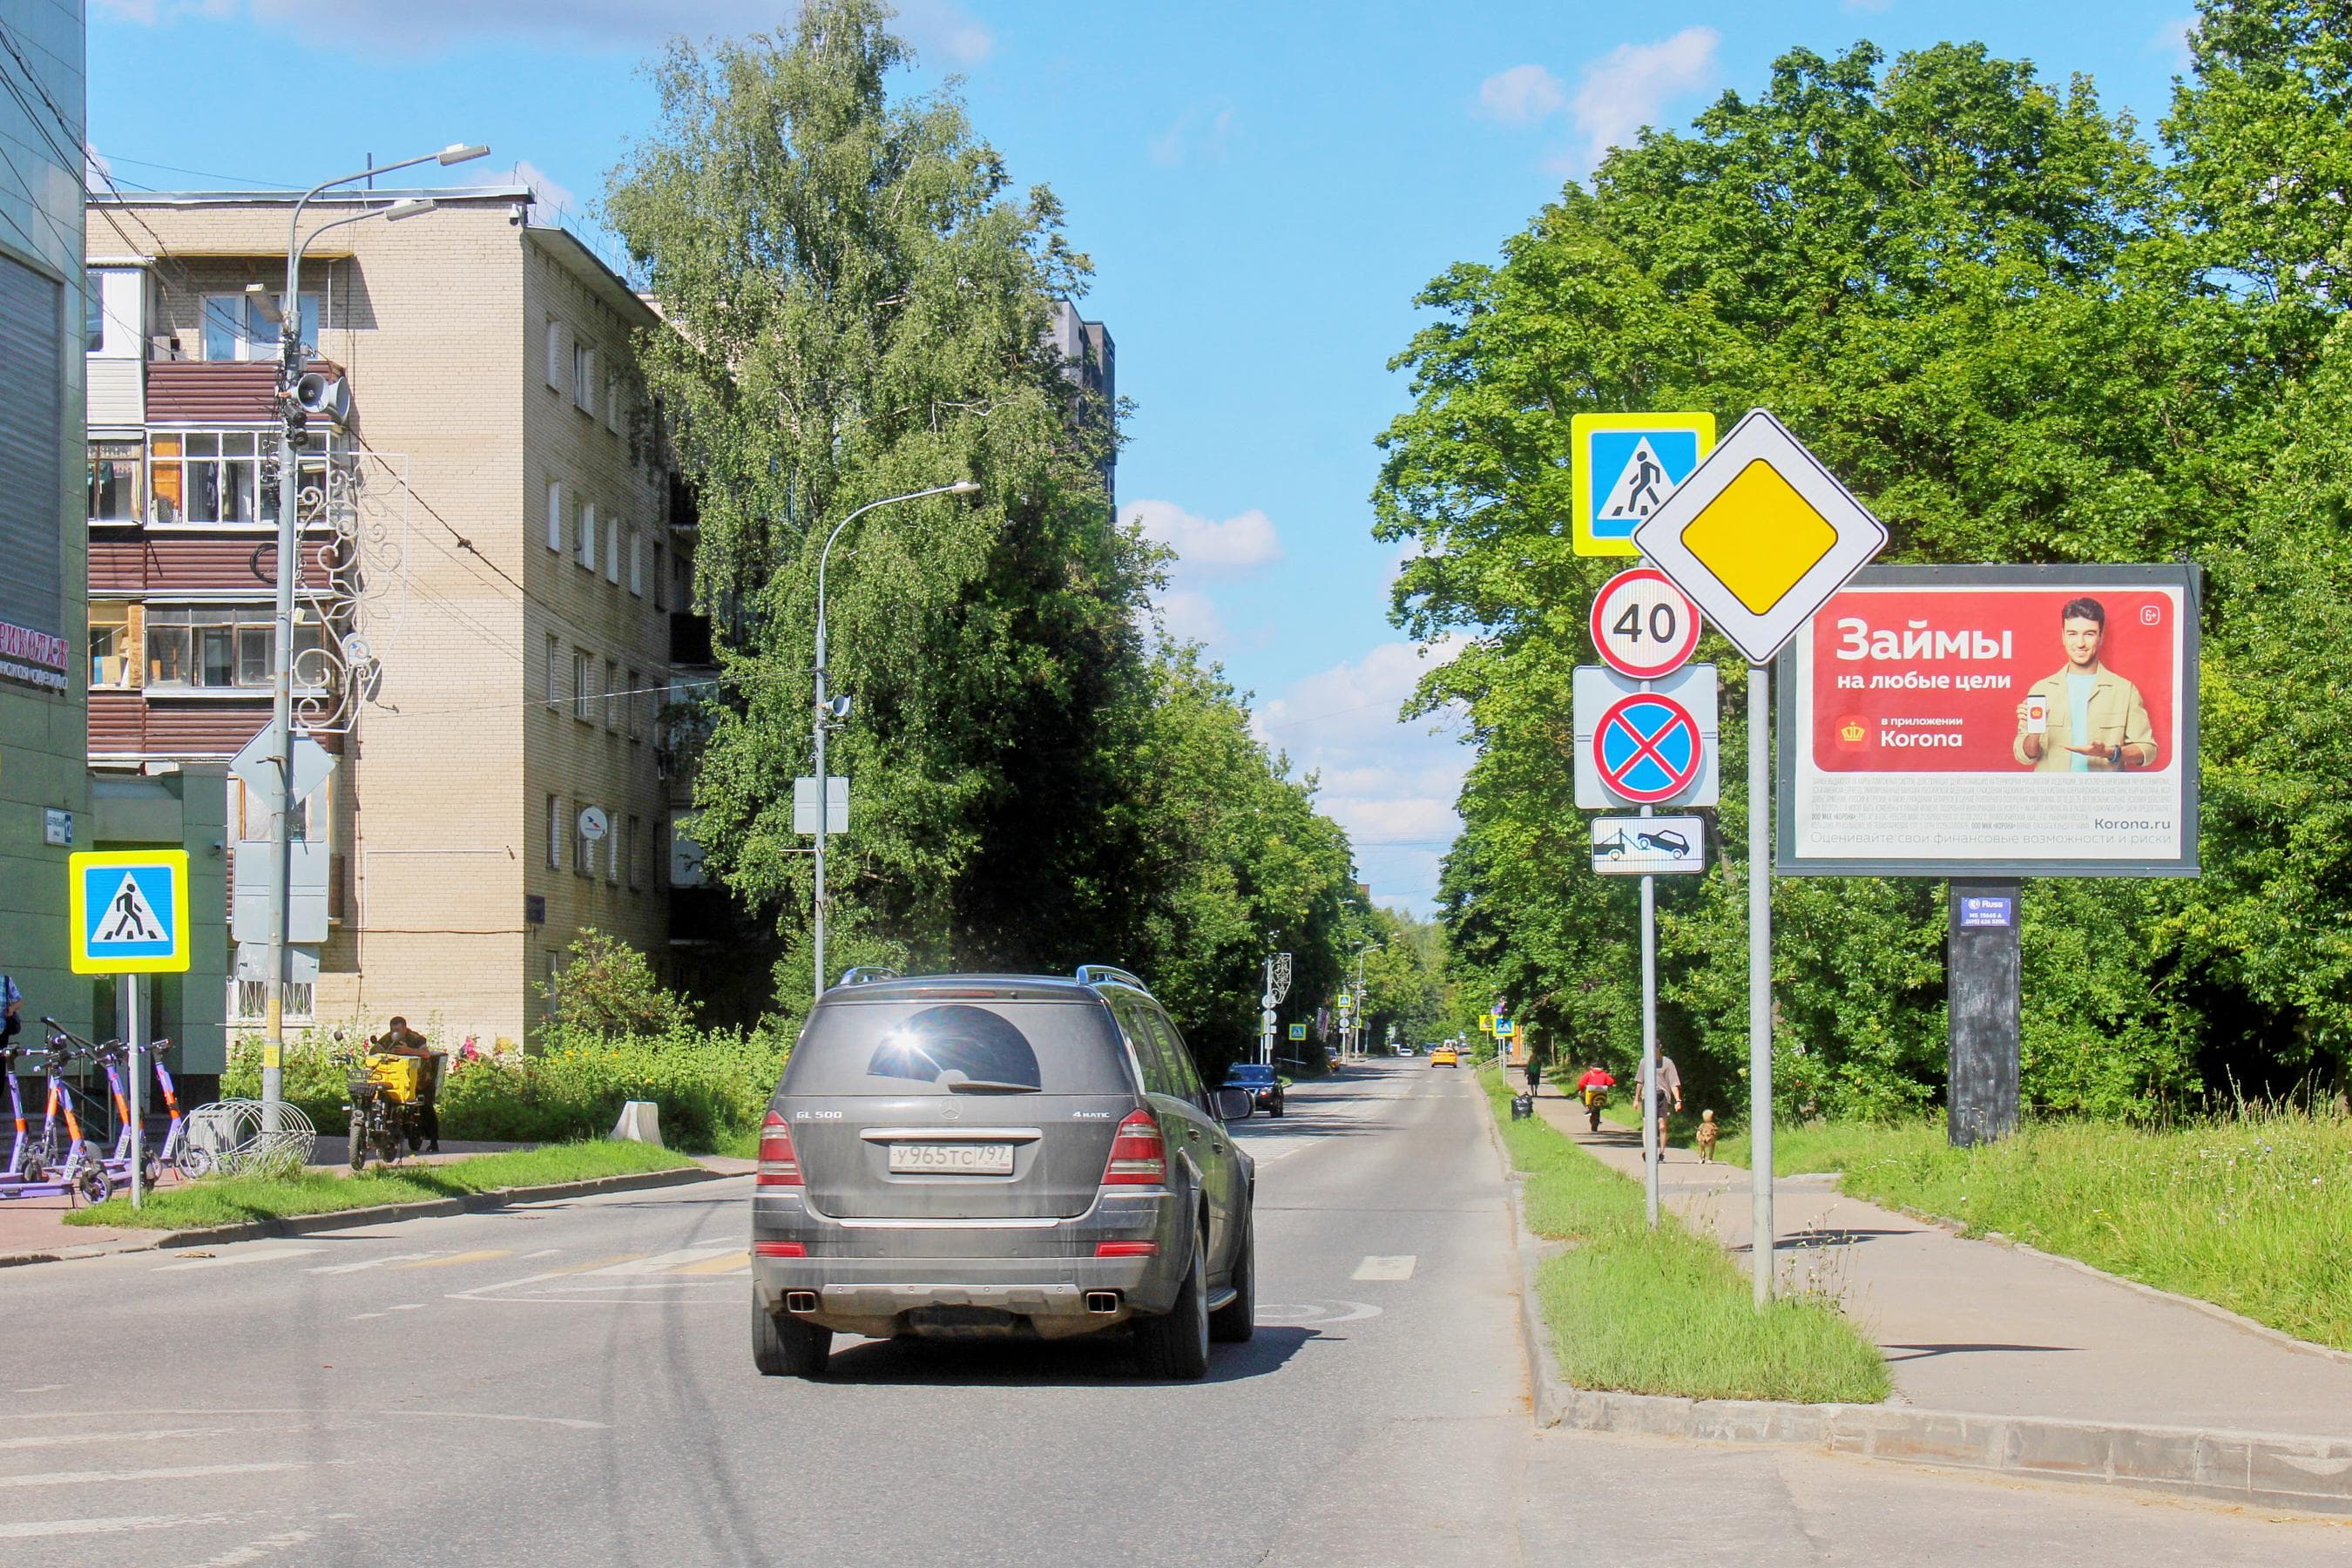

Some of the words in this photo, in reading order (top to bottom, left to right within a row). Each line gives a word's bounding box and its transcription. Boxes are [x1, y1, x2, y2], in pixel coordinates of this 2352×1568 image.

[1612, 602, 1676, 644] 40
[1836, 617, 2013, 661] Займы
[1837, 674, 1865, 689] на
[1869, 671, 1950, 690] любые
[1956, 674, 2011, 692] цели
[1890, 717, 1963, 728] приложении
[1881, 730, 1963, 747] Korona
[2094, 818, 2172, 830] Korona.ru
[1810, 831, 1894, 844] Оценивайте
[1897, 834, 1930, 843] свои
[1932, 832, 2020, 845] финансовые
[2023, 835, 2115, 844] возможности
[2119, 835, 2127, 844] и
[2131, 835, 2173, 846] риски
[796, 1111, 813, 1119] GL
[814, 1111, 842, 1119] 500
[897, 1146, 974, 1166] У965ТС
[977, 1145, 1006, 1161] 797
